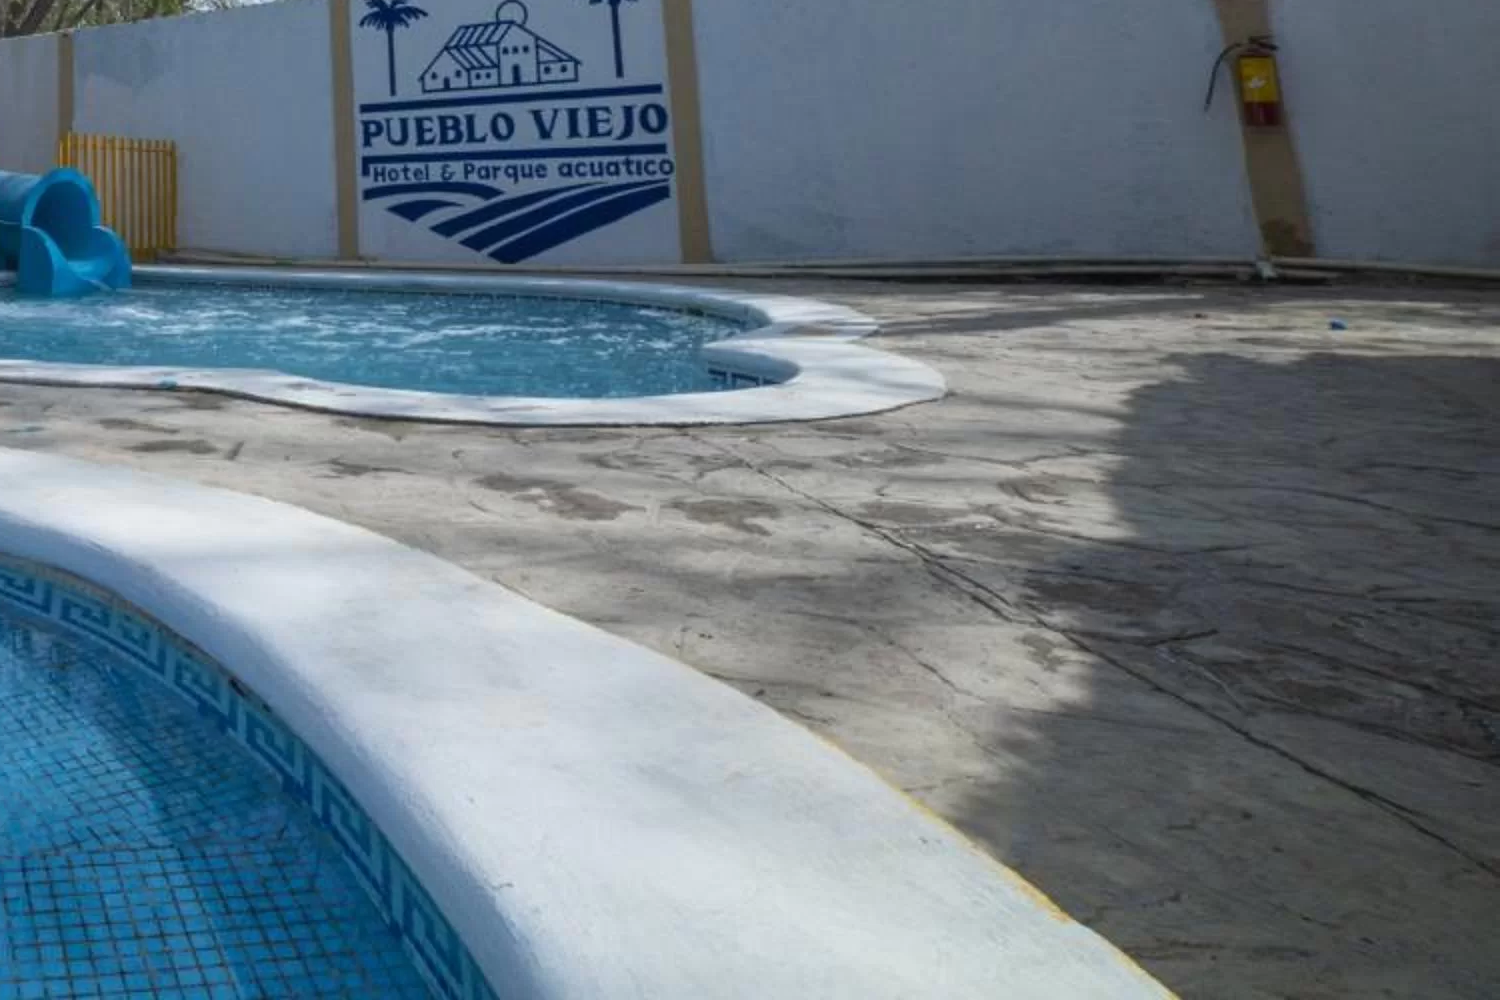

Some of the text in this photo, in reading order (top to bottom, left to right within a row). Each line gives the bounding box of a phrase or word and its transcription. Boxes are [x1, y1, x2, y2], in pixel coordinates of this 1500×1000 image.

[361, 103, 669, 148] PUEBLO VIEJO
[373, 164, 430, 183] Hotel
[440, 164, 456, 182] &
[463, 162, 548, 184] Parque
